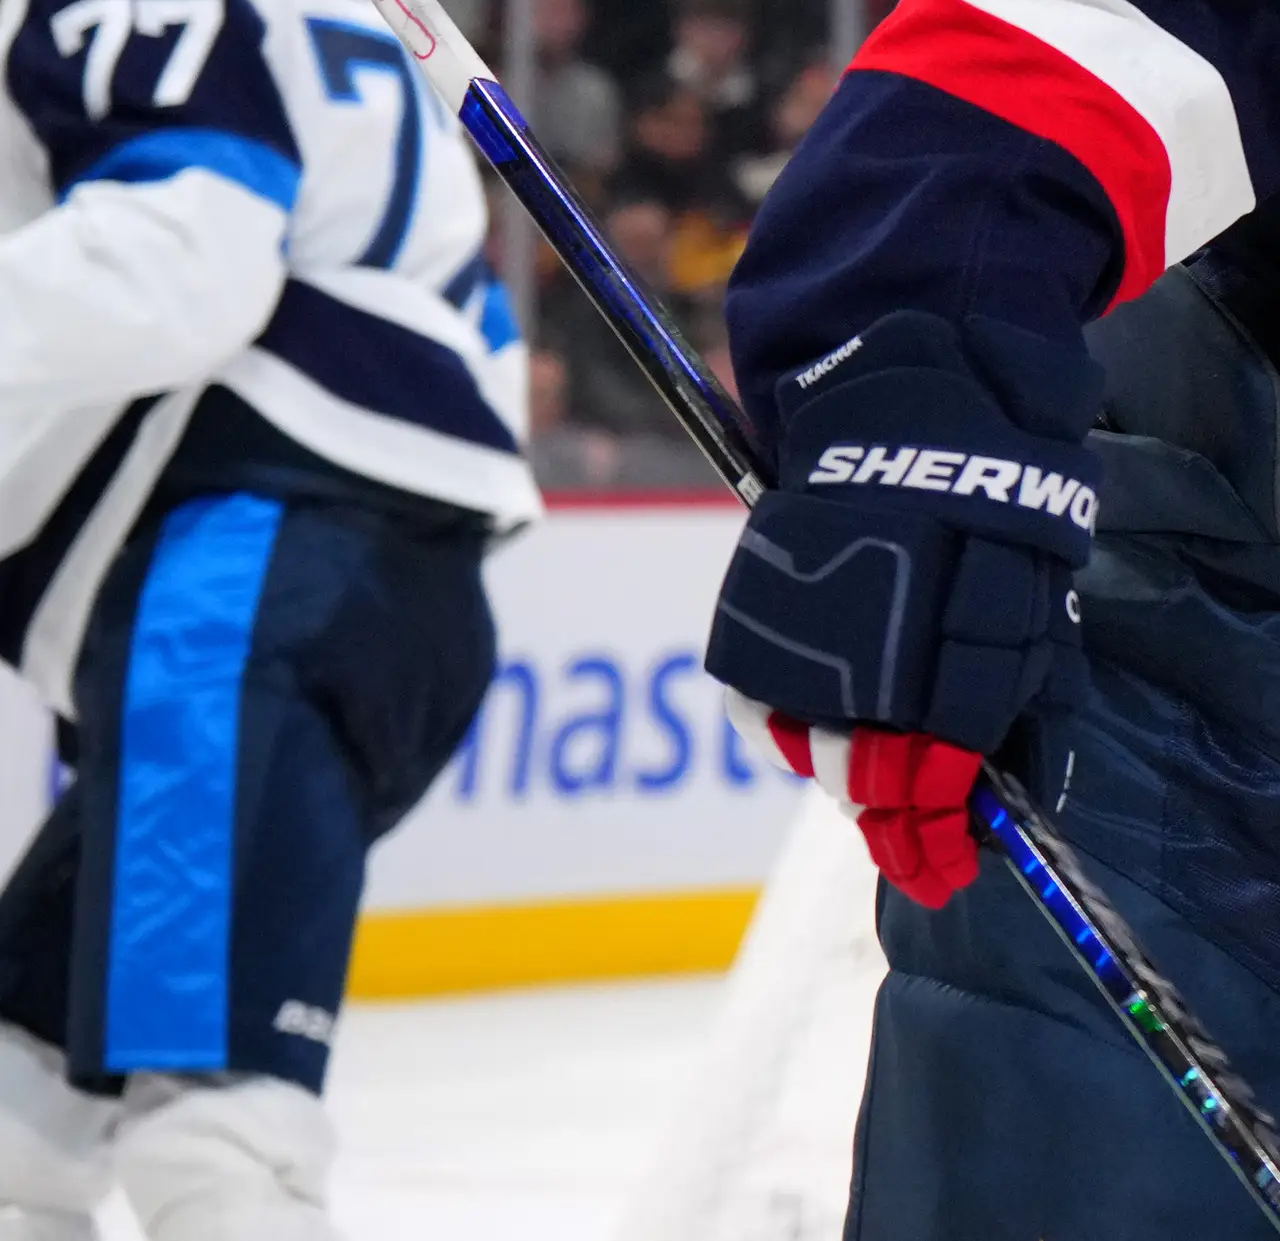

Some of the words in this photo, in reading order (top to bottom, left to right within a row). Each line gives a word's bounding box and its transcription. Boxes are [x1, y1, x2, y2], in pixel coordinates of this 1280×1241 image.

[303, 14, 440, 273] 7
[795, 334, 864, 390] TKACHUK
[808, 445, 1099, 537] SHERWO
